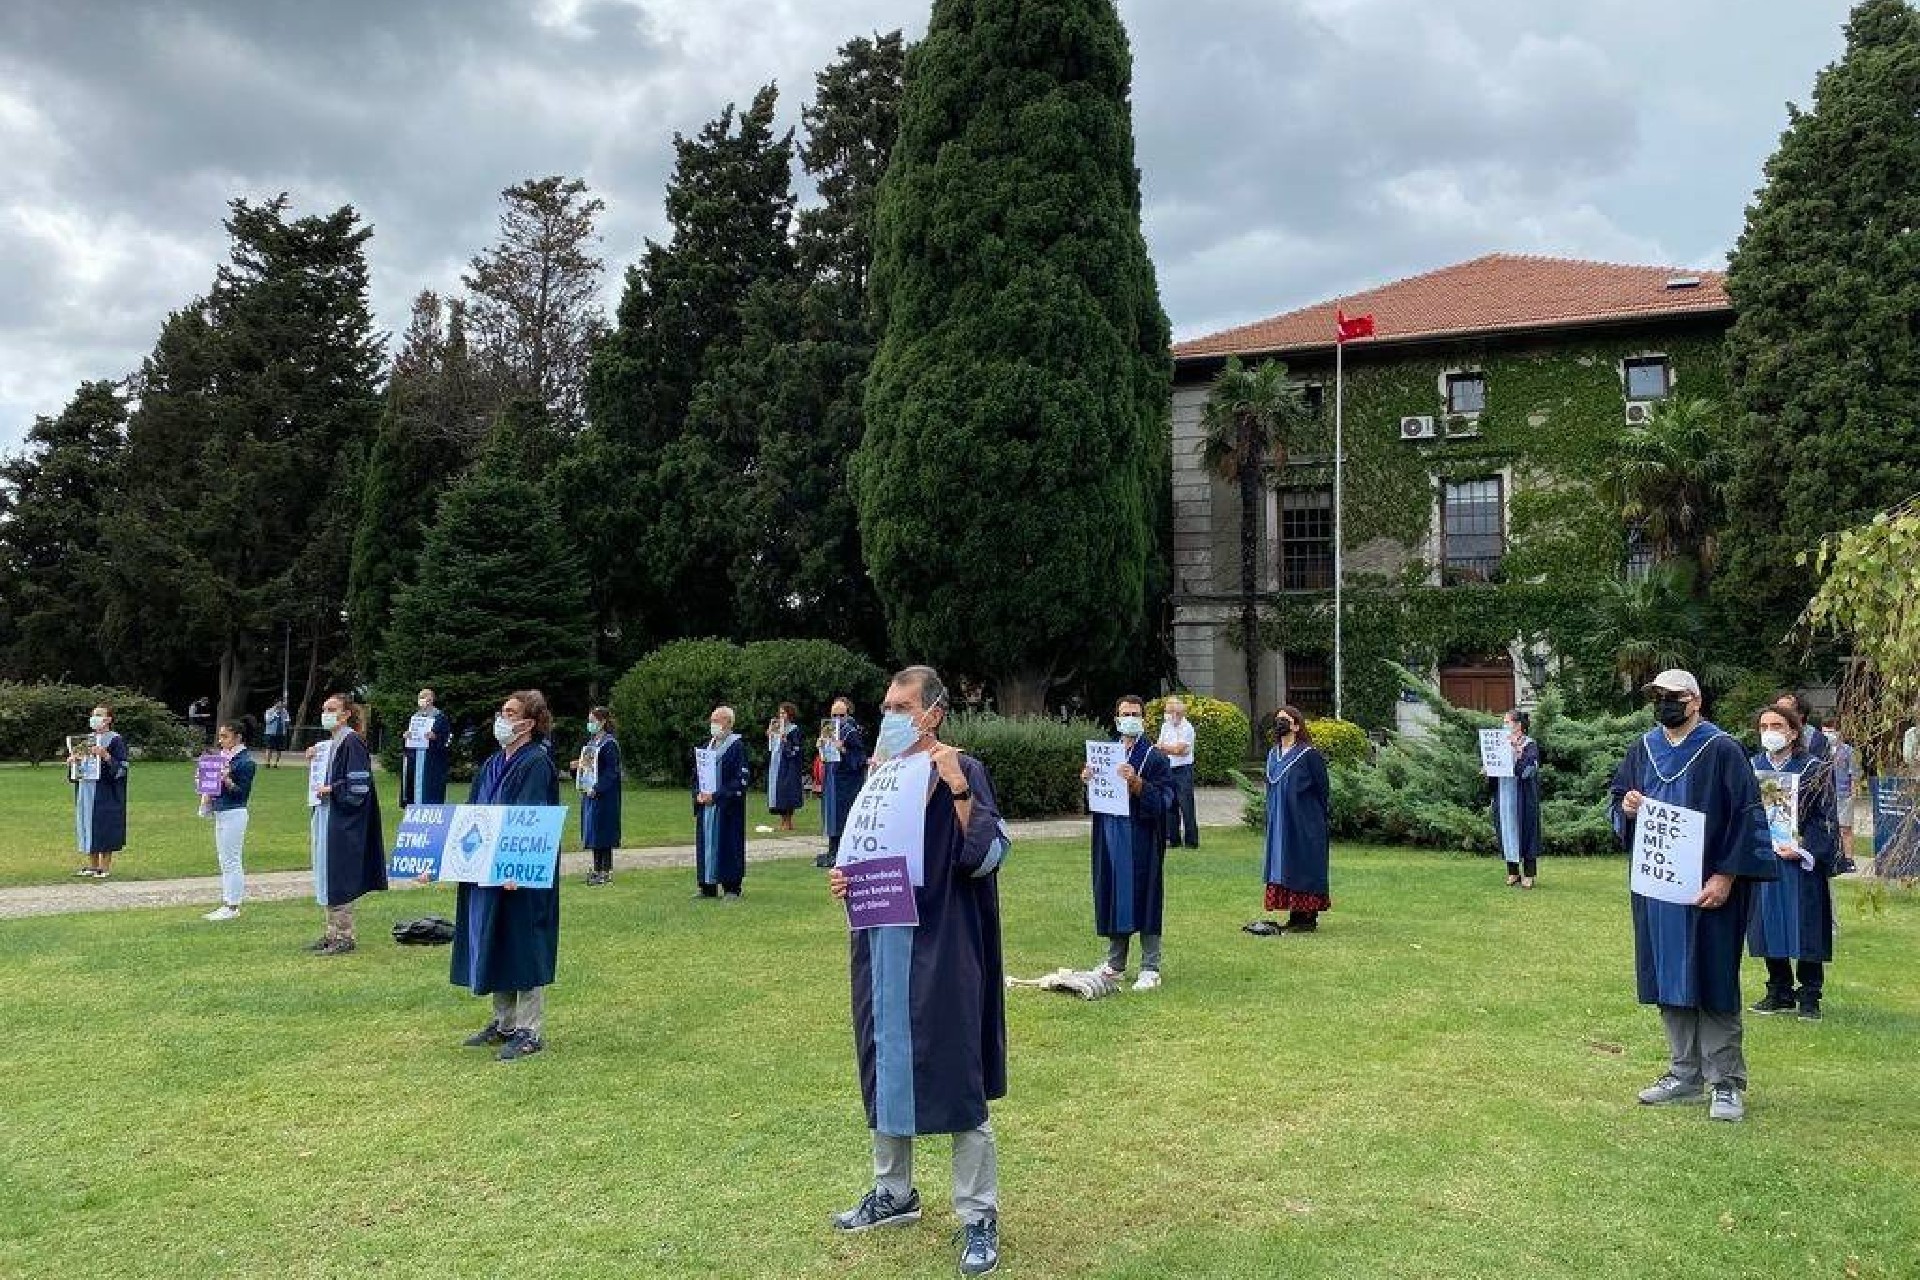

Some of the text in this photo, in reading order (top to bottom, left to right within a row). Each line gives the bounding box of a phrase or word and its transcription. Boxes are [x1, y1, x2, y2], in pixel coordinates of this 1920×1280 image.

[861, 795, 889, 810] ET-
[404, 808, 444, 825] KABUL
[507, 809, 540, 827] VAZ-
[1645, 803, 1688, 824] VAZ-
[1643, 820, 1688, 840] GEÇ-
[852, 835, 888, 852] YO-
[391, 856, 436, 874] YORUZ.
[1643, 847, 1673, 865] YO-
[495, 863, 548, 882] YORUZ.
[1641, 863, 1683, 885] RUZ.
